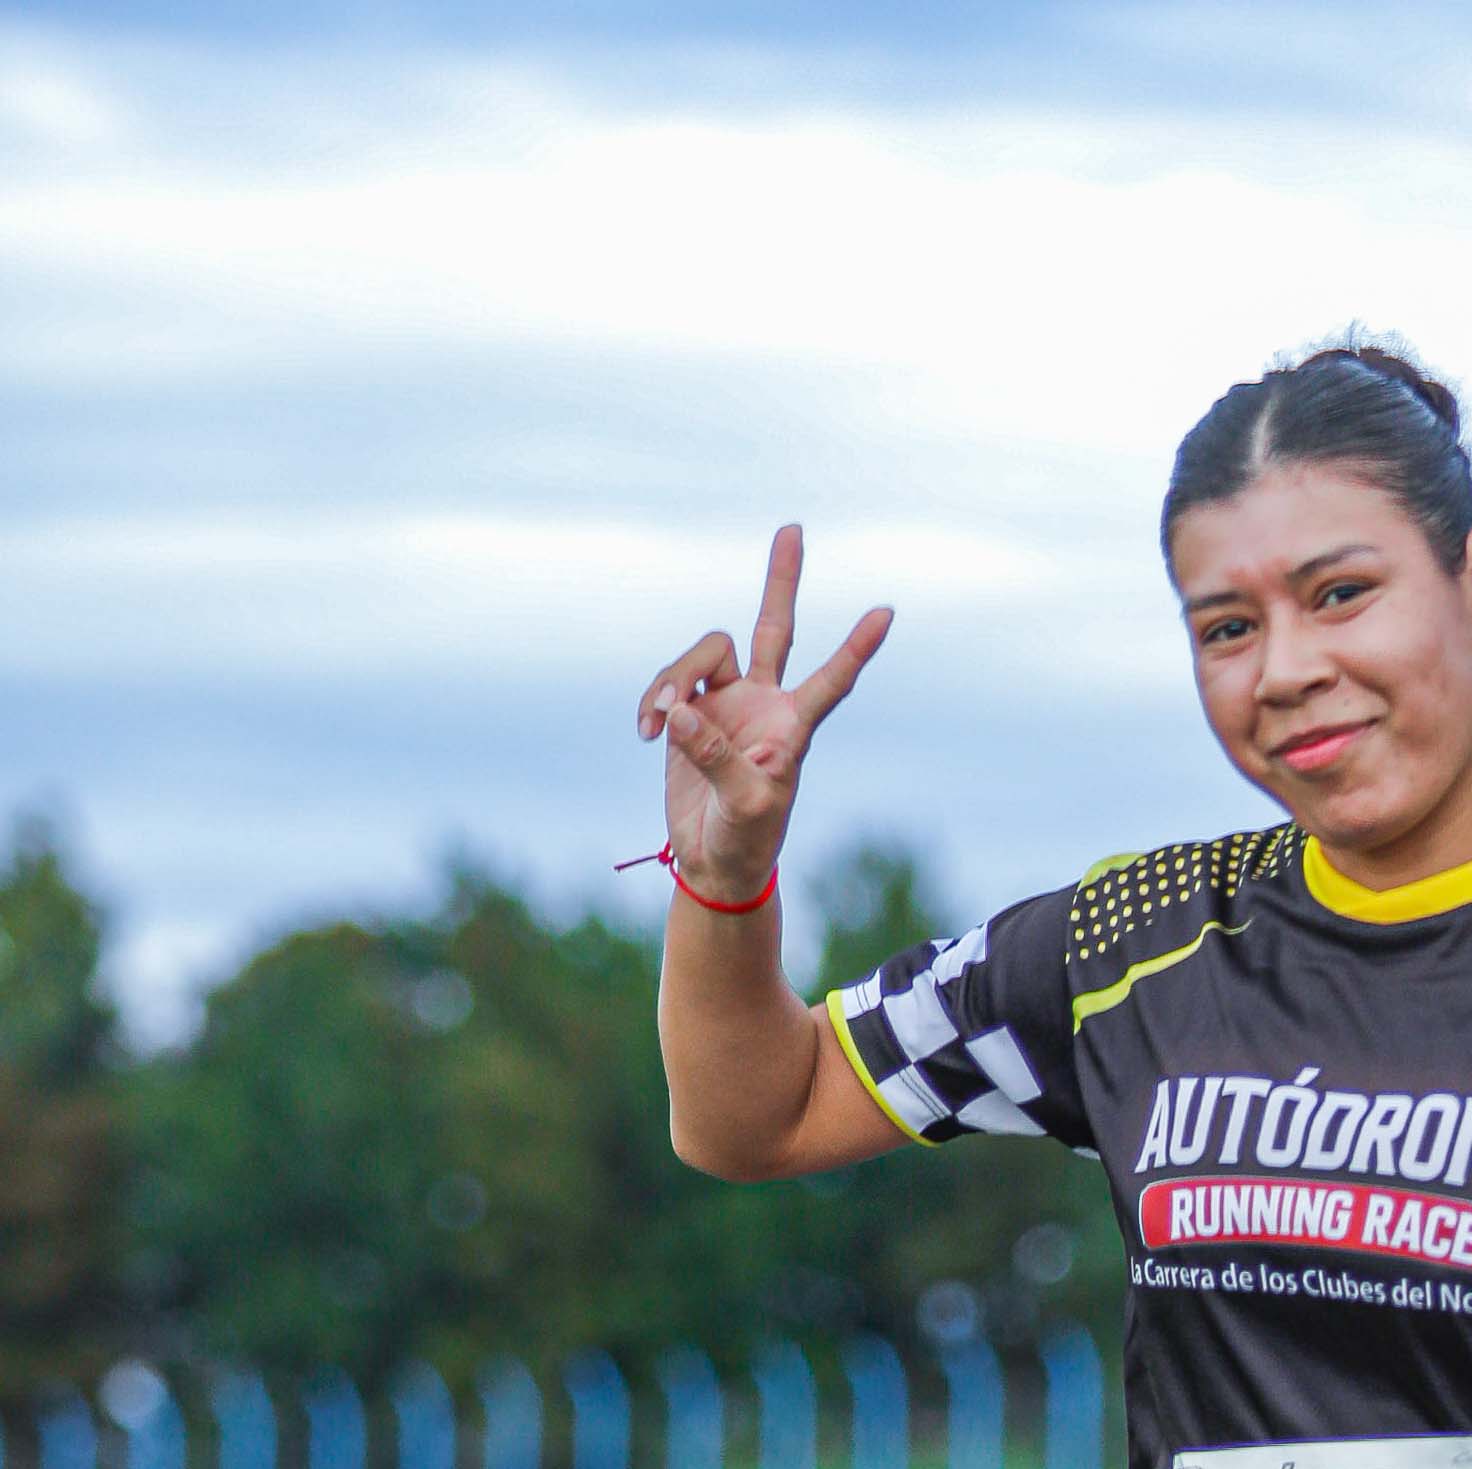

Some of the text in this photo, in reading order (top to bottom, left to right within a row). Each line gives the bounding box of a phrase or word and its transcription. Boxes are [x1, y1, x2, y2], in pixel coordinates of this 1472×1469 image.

[1170, 1184, 1353, 1241] RUNNING
[1144, 1258, 1215, 1289] Carrera
[1221, 1262, 1254, 1291] de
[1259, 1263, 1298, 1294] los
[1303, 1269, 1386, 1304] Clubes
[1392, 1278, 1432, 1310] del
